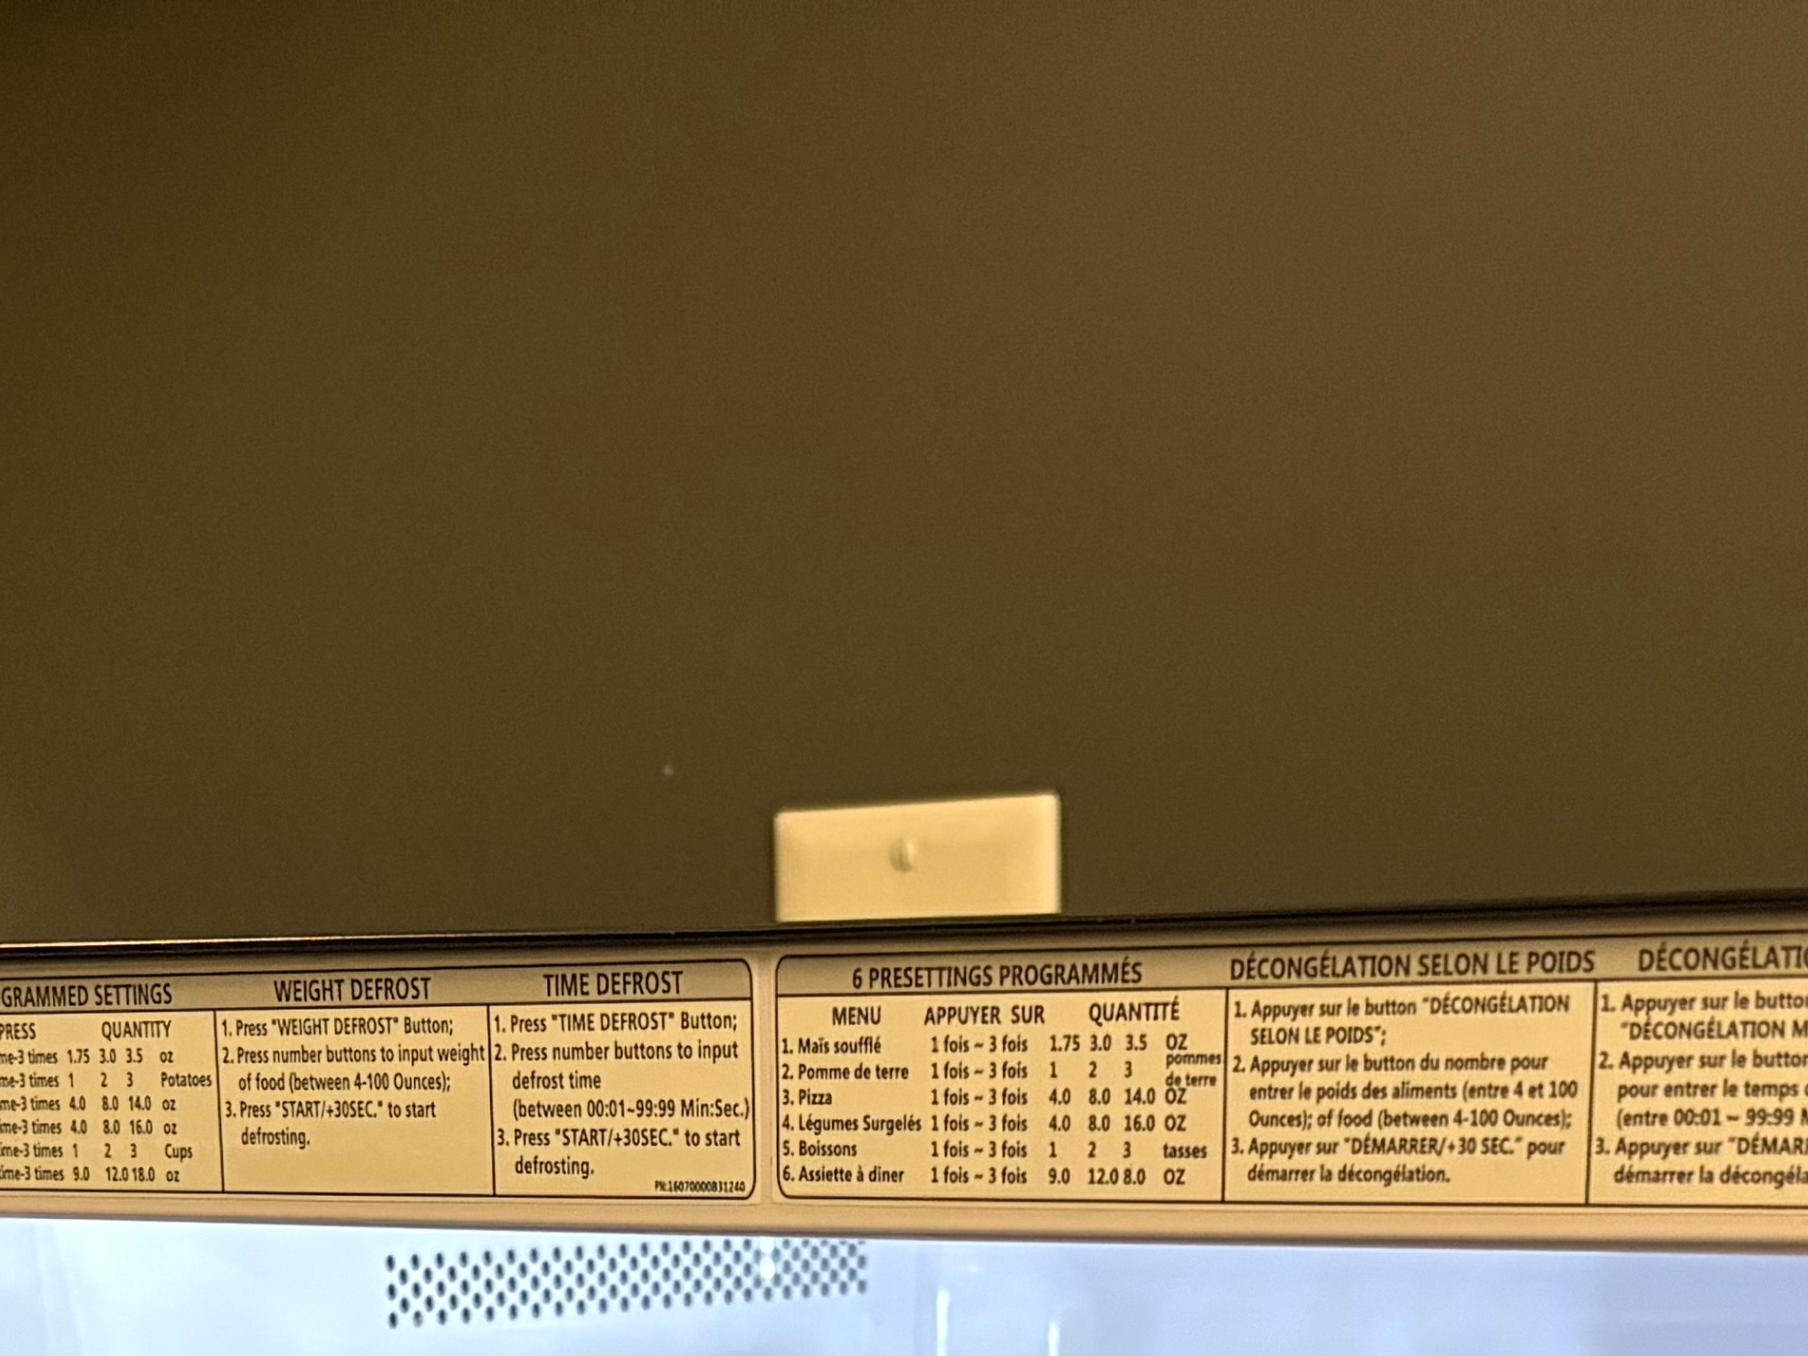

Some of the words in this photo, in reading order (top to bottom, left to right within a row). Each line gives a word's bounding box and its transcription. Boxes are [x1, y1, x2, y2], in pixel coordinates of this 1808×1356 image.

[853, 968, 862, 989] 6
[869, 965, 993, 989] PRESETTINGS
[999, 956, 1142, 986] PROGRAMMÉS
[1231, 951, 1411, 981] DÉCONGÉLATION
[1418, 953, 1488, 976] SELON
[1496, 952, 1520, 974] LE
[1527, 950, 1595, 973] POIDS
[275, 979, 344, 1002] WEIGHT
[351, 977, 431, 1000] DEFROST
[544, 974, 589, 996] TIME
[597, 971, 683, 995] DEFROST
[94, 983, 172, 1006] SETTINGS
[1602, 994, 1615, 1011] 1.
[1621, 993, 1694, 1016] Appuyer
[1701, 995, 1728, 1011] sur
[1734, 992, 1749, 1010] le
[832, 1006, 881, 1025] MENU
[924, 1006, 1001, 1026] APPUYER
[1011, 1005, 1045, 1024] SUR
[1089, 996, 1180, 1026] QUANTITÉ
[1234, 1001, 1247, 1018] 1.
[1251, 999, 1314, 1022] Appuyer
[1319, 999, 1342, 1017] sur
[1347, 998, 1360, 1016] le
[1365, 994, 1417, 1016] button
[102, 1021, 171, 1041] QUANTITY
[222, 1021, 232, 1036] 1.
[236, 1020, 267, 1036] Press
[404, 1017, 453, 1036] Button;
[494, 1016, 506, 1033] 1.
[510, 1015, 546, 1032] Press
[681, 1012, 737, 1031] Button;
[223, 1048, 233, 1064] 2.
[237, 1048, 269, 1063] Press
[273, 1045, 322, 1063] number
[326, 1046, 376, 1062] buttons
[380, 1047, 392, 1062] to
[398, 1044, 433, 1066] input
[437, 1044, 485, 1065] weight
[494, 1044, 507, 1061] 2.
[511, 1043, 548, 1061] Press
[552, 1041, 609, 1060] number
[614, 1041, 673, 1059] buttons
[677, 1043, 692, 1059] to
[698, 1040, 738, 1064] input
[782, 1038, 793, 1054] 1.
[798, 1037, 829, 1054] Maïs
[834, 1036, 881, 1054] soufflé
[68, 1050, 90, 1064] 1.75
[99, 1050, 116, 1063] 3.0
[126, 1049, 143, 1063] 3.5
[160, 1052, 173, 1063] oz
[101, 1073, 107, 1087] 2
[127, 1073, 133, 1087] 3
[161, 1072, 212, 1087] Potatoes
[512, 1071, 564, 1089] defrost
[569, 1070, 601, 1088] time
[782, 1064, 793, 1079] 2.
[798, 1063, 850, 1079] Pomme
[854, 1063, 871, 1079] de
[876, 1064, 909, 1079] terre
[239, 1073, 253, 1090] of
[256, 1072, 285, 1090] food
[289, 1072, 350, 1093] (between
[354, 1072, 389, 1089] 4-100
[394, 1071, 450, 1093] Ounces);
[69, 1097, 86, 1111] 4.0
[102, 1096, 119, 1111] 8.0
[129, 1096, 151, 1110] 14.0
[163, 1100, 176, 1110] oz
[783, 1089, 794, 1105] 3.
[799, 1089, 832, 1105] Pizza
[226, 1102, 236, 1117] 3.
[240, 1101, 271, 1117] Press
[388, 1101, 401, 1117] to
[406, 1101, 436, 1117] start
[513, 1099, 582, 1120] (between
[587, 1099, 675, 1117] 00:01~99:99
[681, 1098, 750, 1119] Min:Sec.)
[71, 1119, 87, 1134] 4.0
[103, 1119, 120, 1134] 8.0
[130, 1119, 152, 1134] 16.0
[164, 1122, 177, 1134] oz
[782, 1115, 794, 1131] 4.
[799, 1114, 858, 1135] Légumes
[863, 1113, 921, 1134] Surgelés
[241, 1127, 310, 1149] defrosting.
[497, 1129, 509, 1146] 3.
[514, 1129, 550, 1146] Press
[685, 1129, 700, 1146] to
[705, 1128, 740, 1146] start
[165, 1144, 193, 1160] Cups
[783, 1141, 794, 1157] 5.
[799, 1140, 857, 1157] Boissons
[515, 1155, 594, 1179] defrosting.
[783, 1167, 794, 1182] 6.
[799, 1166, 852, 1182] Assiette
[857, 1166, 864, 1182] à
